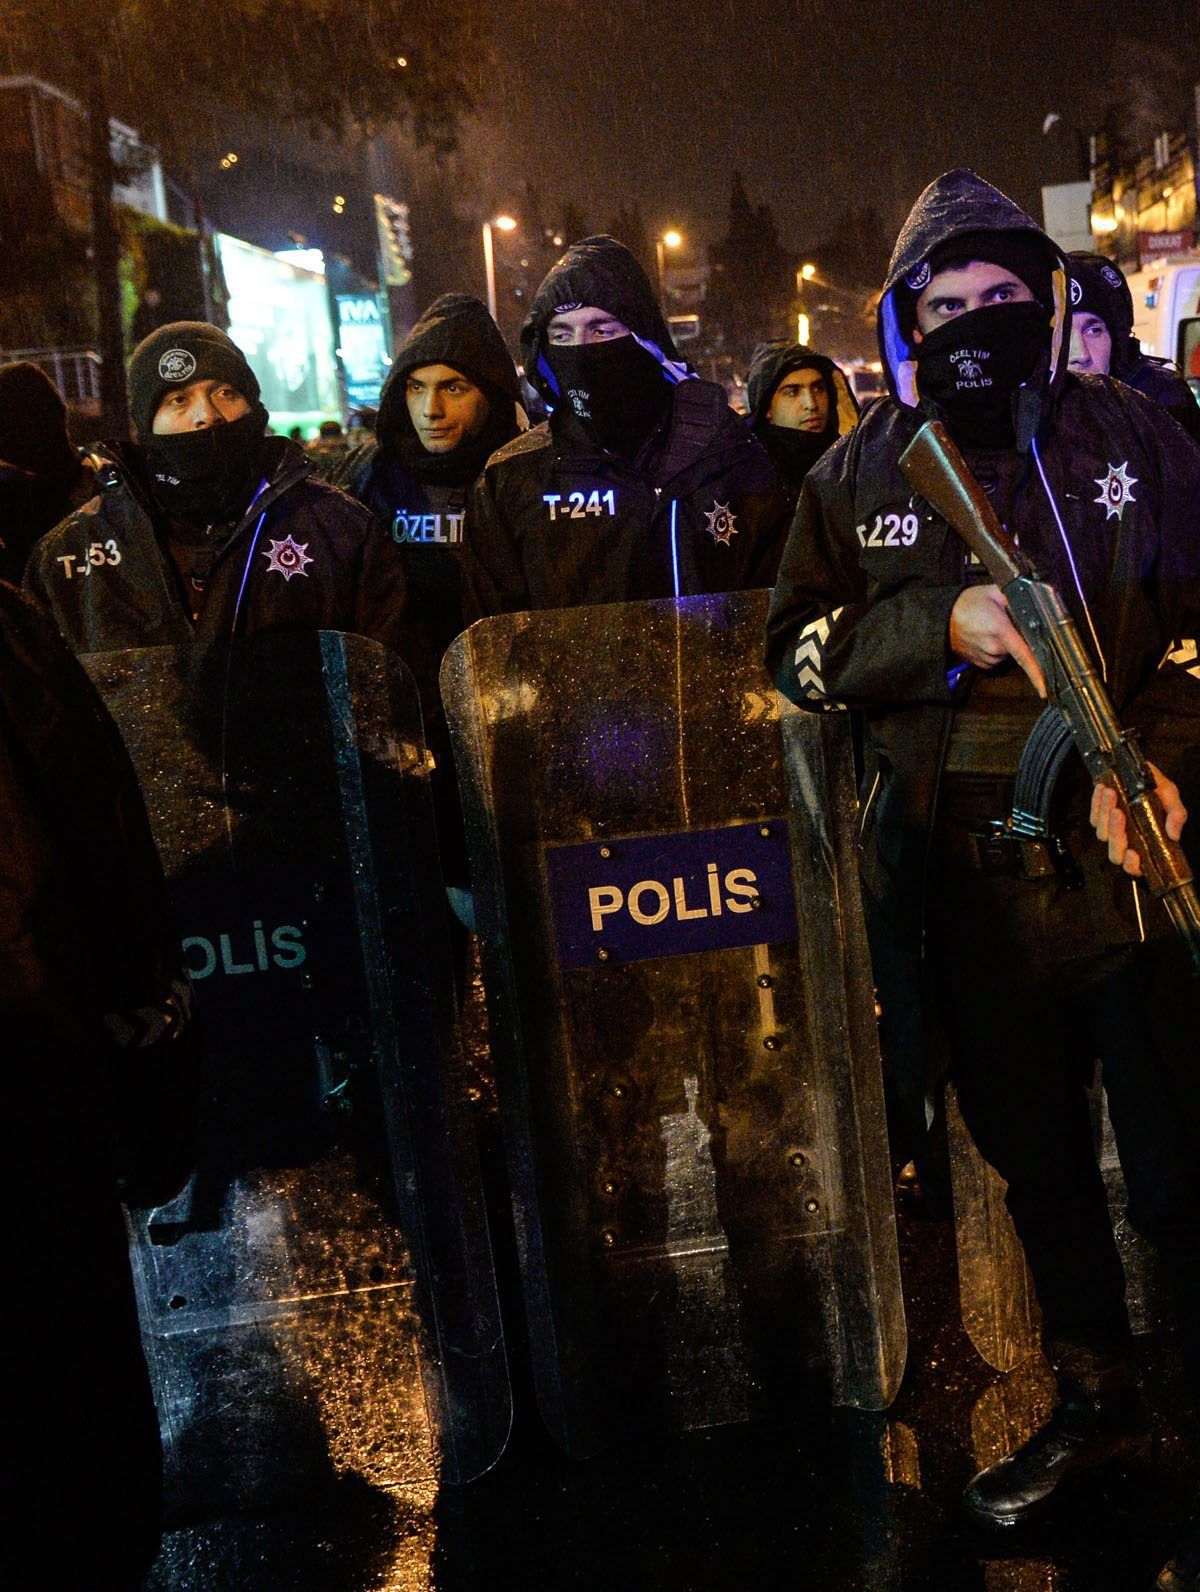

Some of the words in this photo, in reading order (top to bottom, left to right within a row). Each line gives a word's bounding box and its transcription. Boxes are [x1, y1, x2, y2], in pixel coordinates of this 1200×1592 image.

[543, 490, 615, 520] T-241
[57, 539, 121, 578] T-53
[589, 863, 760, 932] POLİS
[181, 919, 307, 980] OLİS
